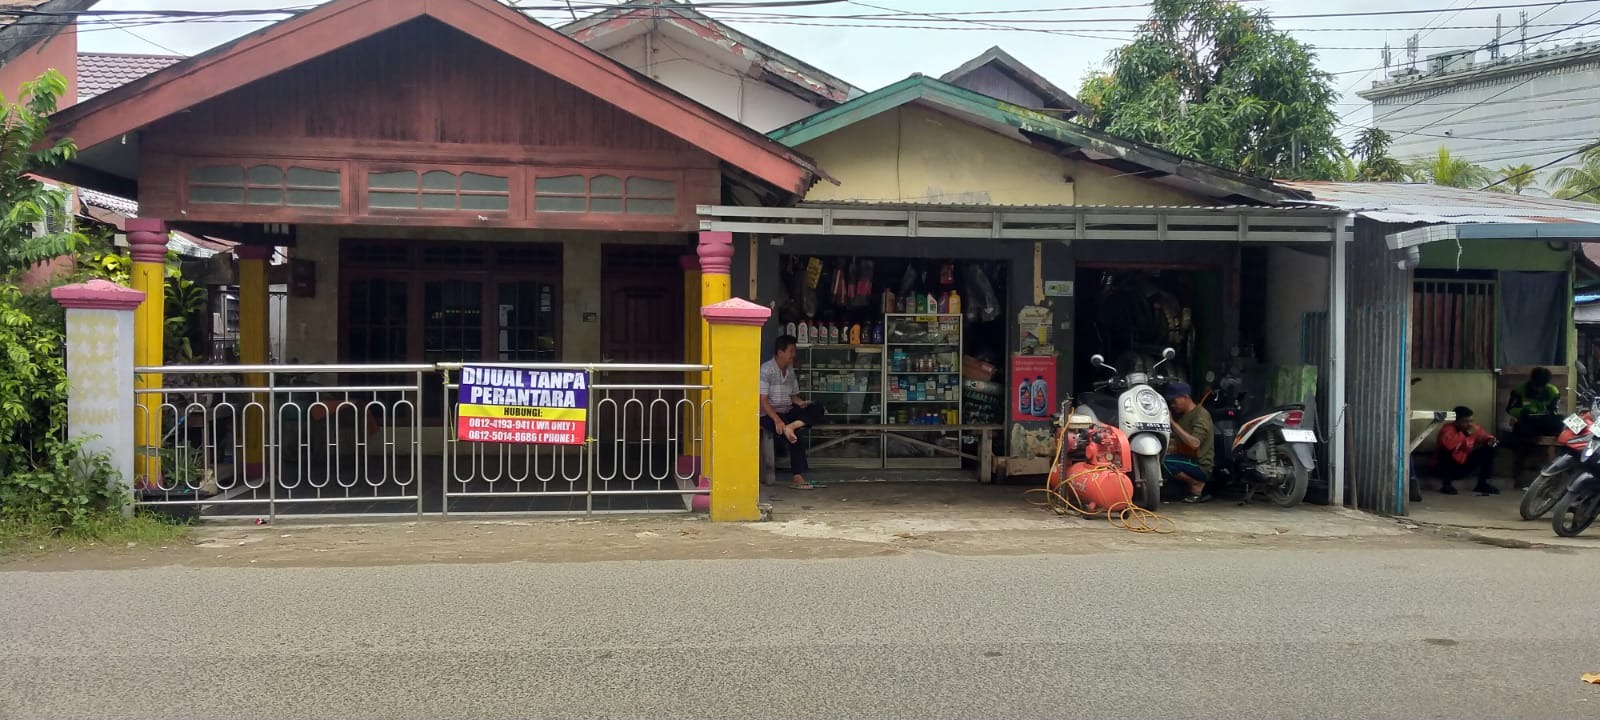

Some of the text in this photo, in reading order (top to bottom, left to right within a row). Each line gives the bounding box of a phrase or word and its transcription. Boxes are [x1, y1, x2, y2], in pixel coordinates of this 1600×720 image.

[463, 367, 586, 390] DIJUAL TANPA
[471, 386, 576, 408] PERANTARA
[503, 407, 543, 417] HUBUNGI:
[469, 418, 530, 430] 0812-4193-941
[468, 430, 537, 442] 0812-5014-8686
